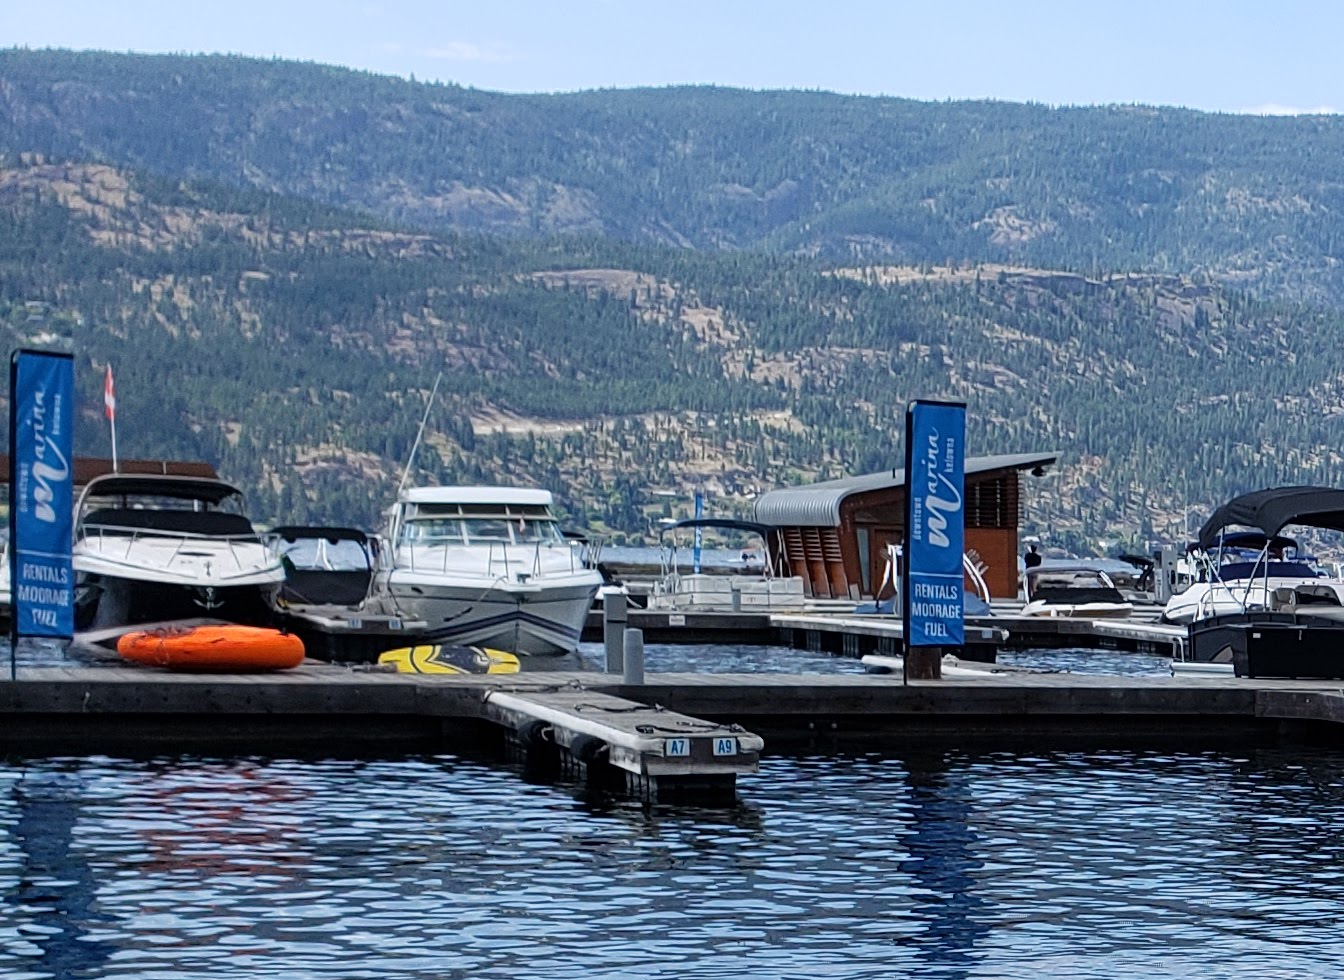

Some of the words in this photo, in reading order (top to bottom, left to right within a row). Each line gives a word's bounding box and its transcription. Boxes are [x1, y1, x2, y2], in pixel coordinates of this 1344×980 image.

[27, 383, 68, 522] Marina
[921, 427, 961, 548] Marina
[23, 563, 68, 584] RENTALS
[18, 584, 69, 606] MOORAGE
[914, 583, 958, 600] RENTALS
[911, 602, 961, 619] MOORAGE
[924, 622, 948, 637] FUEL
[671, 740, 685, 754] A7
[718, 739, 732, 753] A9
